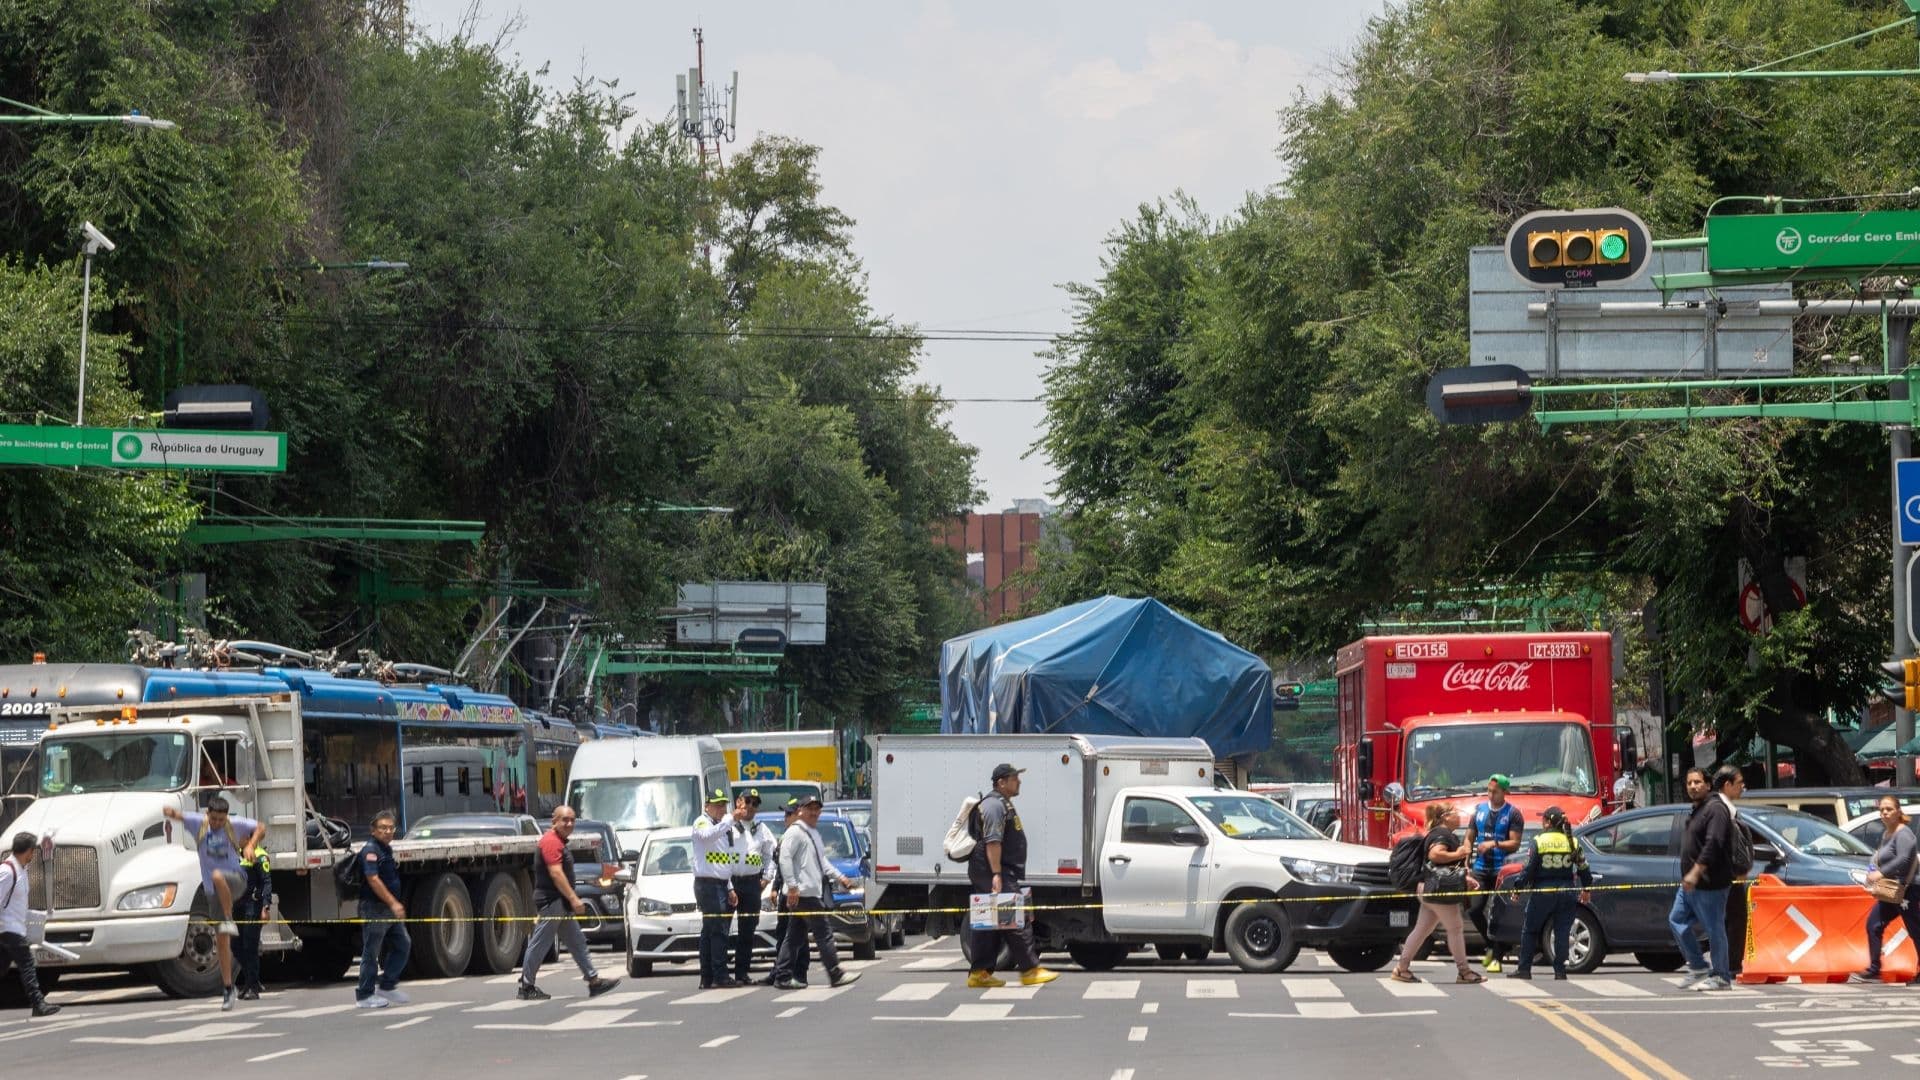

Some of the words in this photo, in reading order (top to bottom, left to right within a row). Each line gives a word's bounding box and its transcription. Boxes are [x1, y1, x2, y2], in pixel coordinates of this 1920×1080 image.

[1808, 234, 1861, 244] Corredor
[1864, 232, 1892, 242] Cero
[1565, 269, 1593, 279] CDMX
[61, 441, 74, 450] Eje
[76, 441, 108, 450] Central
[150, 442, 202, 454] República
[205, 444, 217, 453] de
[221, 444, 264, 456] Uruguay
[1397, 644, 1446, 657] EIO155
[1442, 661, 1533, 691] Coca-Cola
[1, 702, 52, 715] 20027
[111, 829, 137, 856] NLM19
[1542, 854, 1572, 868] SSC
